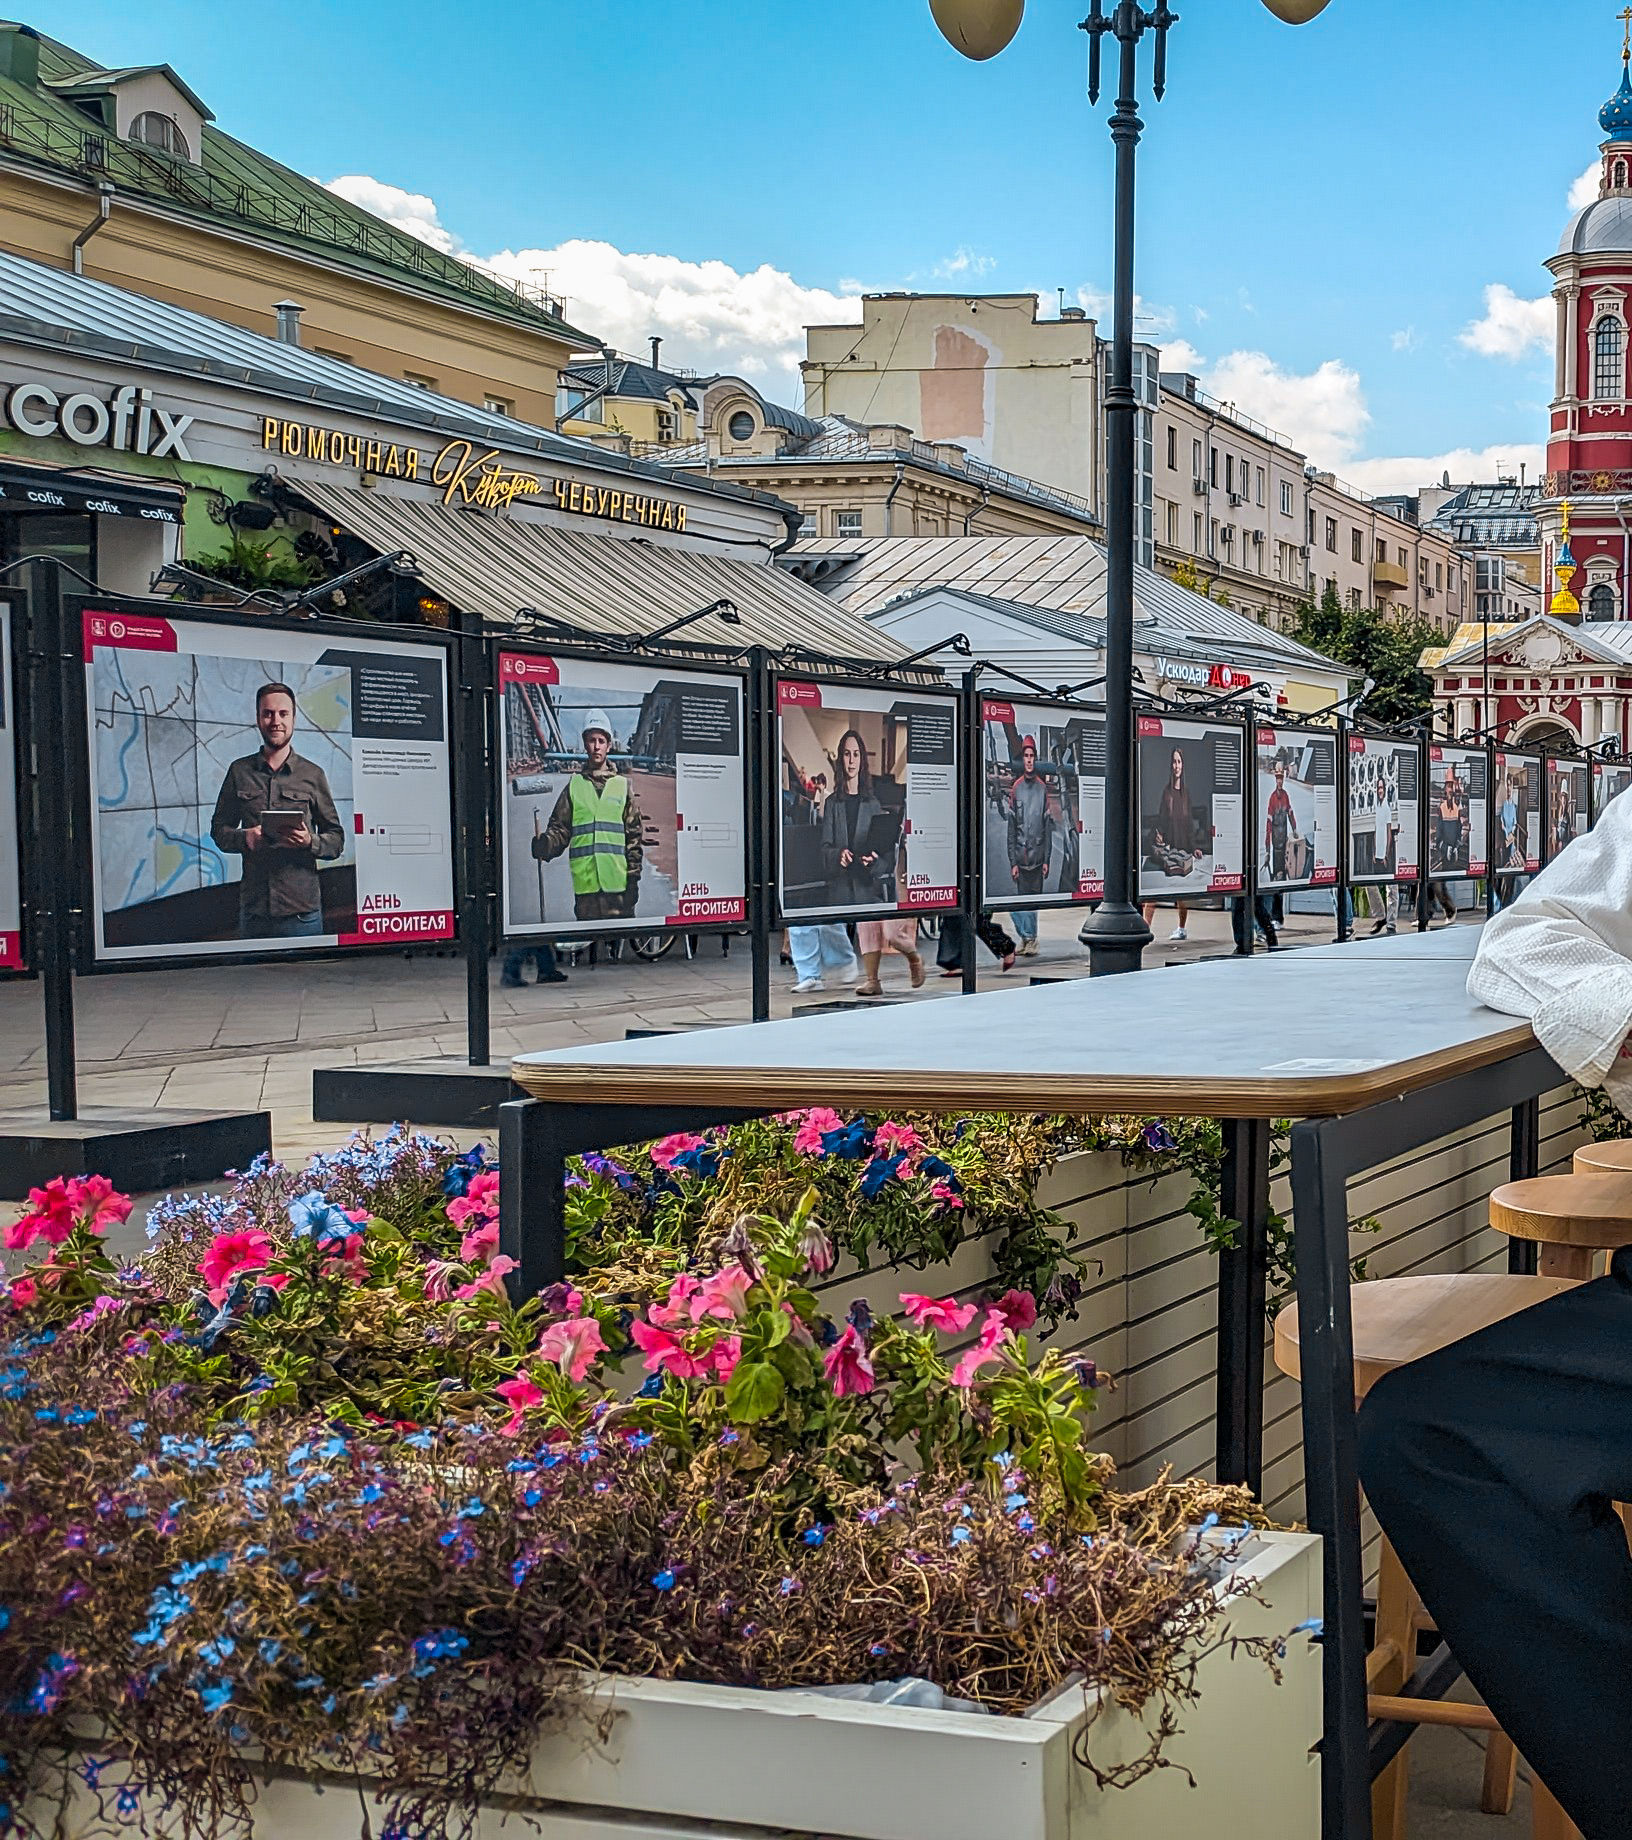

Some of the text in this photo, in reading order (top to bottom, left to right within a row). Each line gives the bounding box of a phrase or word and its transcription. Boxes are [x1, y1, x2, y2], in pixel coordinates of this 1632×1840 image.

[10, 383, 195, 462] cofix
[264, 416, 419, 480] РЮМОЧНАЯ
[553, 479, 687, 532] ЧЕБУРЕЧНАЯ
[28, 491, 66, 507] cofix
[86, 501, 122, 514] cofix
[140, 509, 177, 522] cofix
[1158, 657, 1210, 688] Ускюдар
[910, 874, 931, 887] ДЕНЬ
[681, 883, 710, 898] ДЕНЬ
[910, 889, 954, 903] СТРОИТЕЛЯ
[362, 893, 402, 911] ДЕНЬ
[682, 901, 740, 916] СТРОИТЕЛЯ
[363, 914, 446, 934] СТРОИТЕЛЯ
